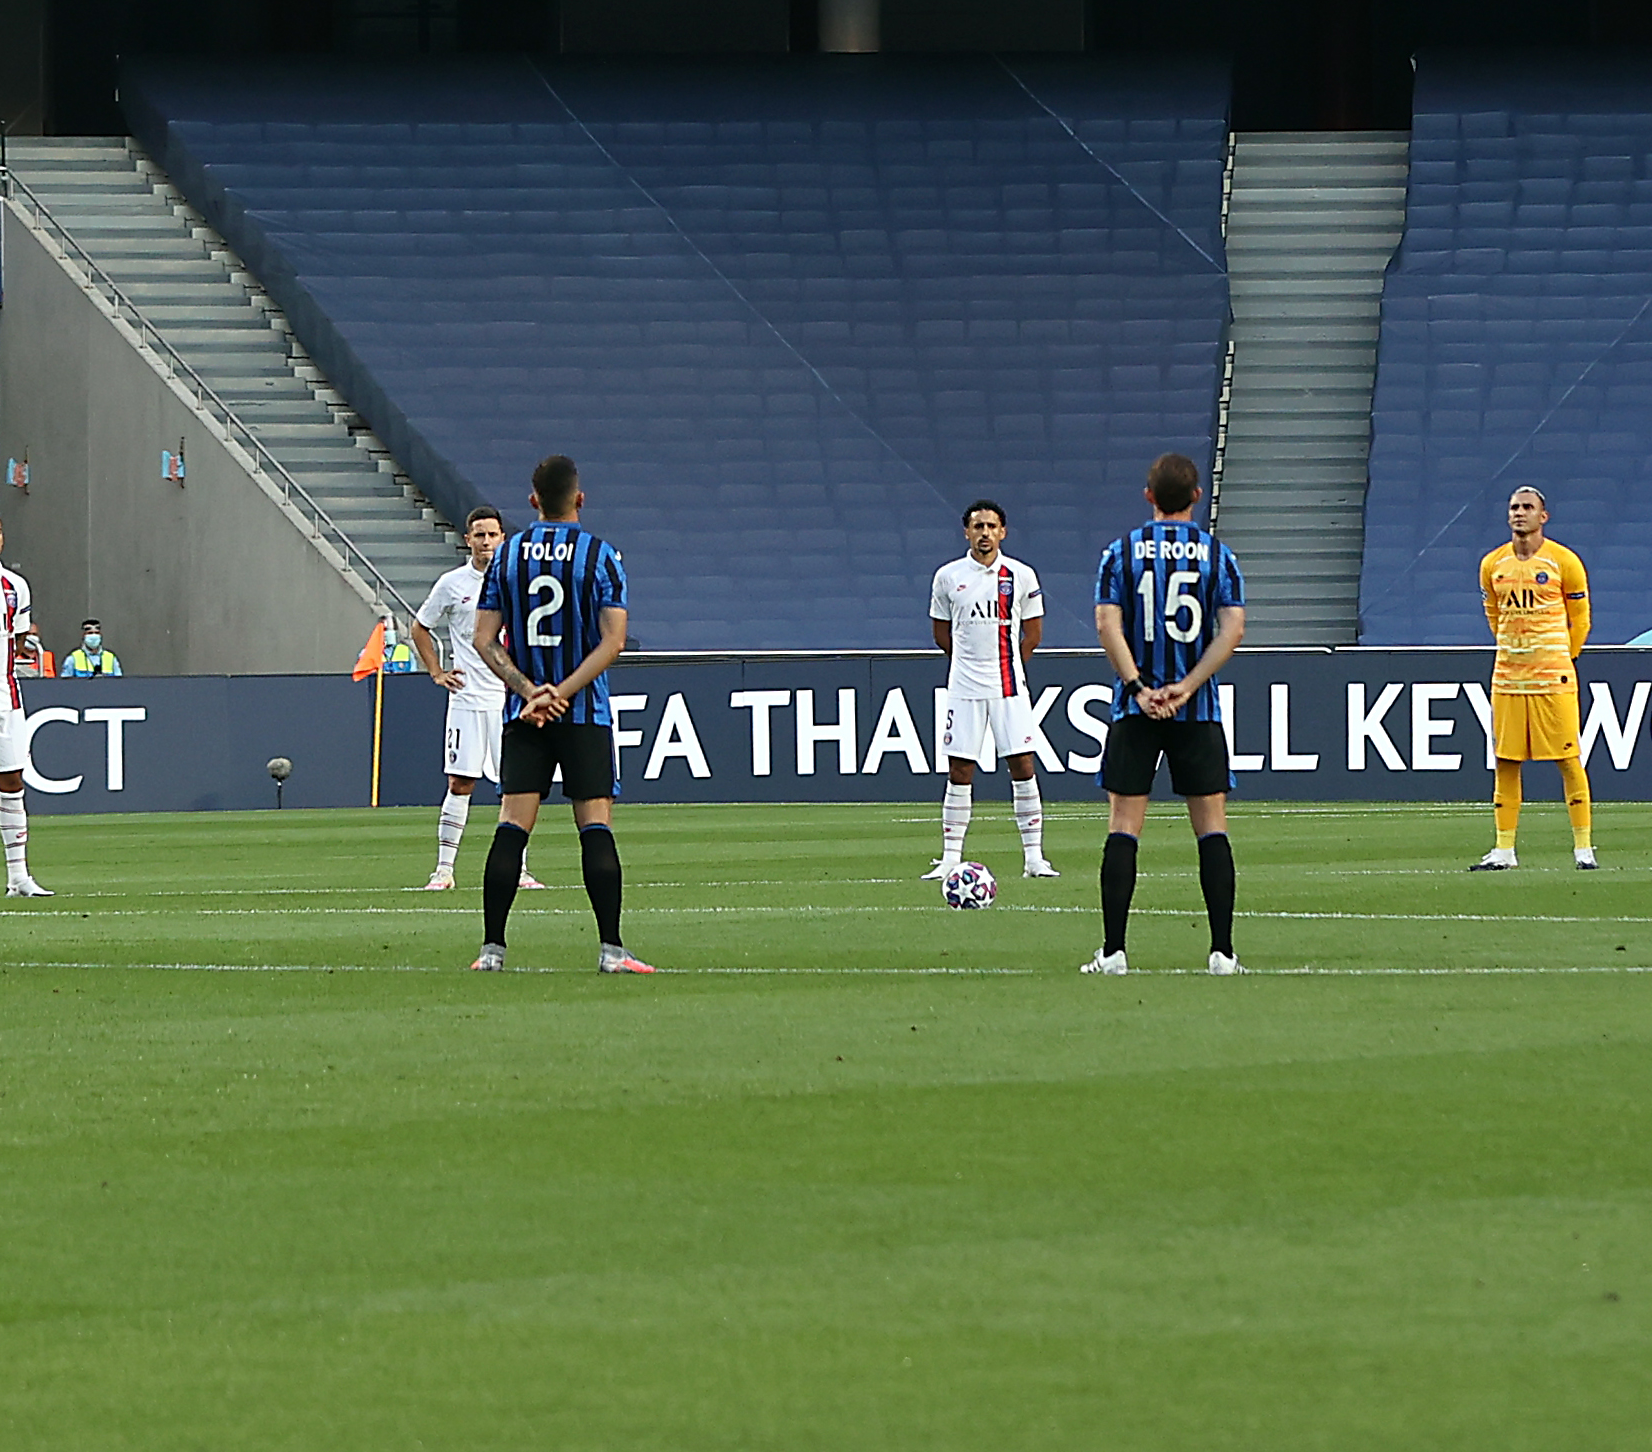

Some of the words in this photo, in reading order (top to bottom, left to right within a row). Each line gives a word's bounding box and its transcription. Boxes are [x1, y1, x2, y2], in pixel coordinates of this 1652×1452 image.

[522, 542, 574, 561] TOLOI
[1134, 540, 1156, 559] DE
[1160, 541, 1209, 562] ROON
[527, 575, 564, 647] 2
[1137, 570, 1203, 643] 15
[448, 728, 461, 750] 21
